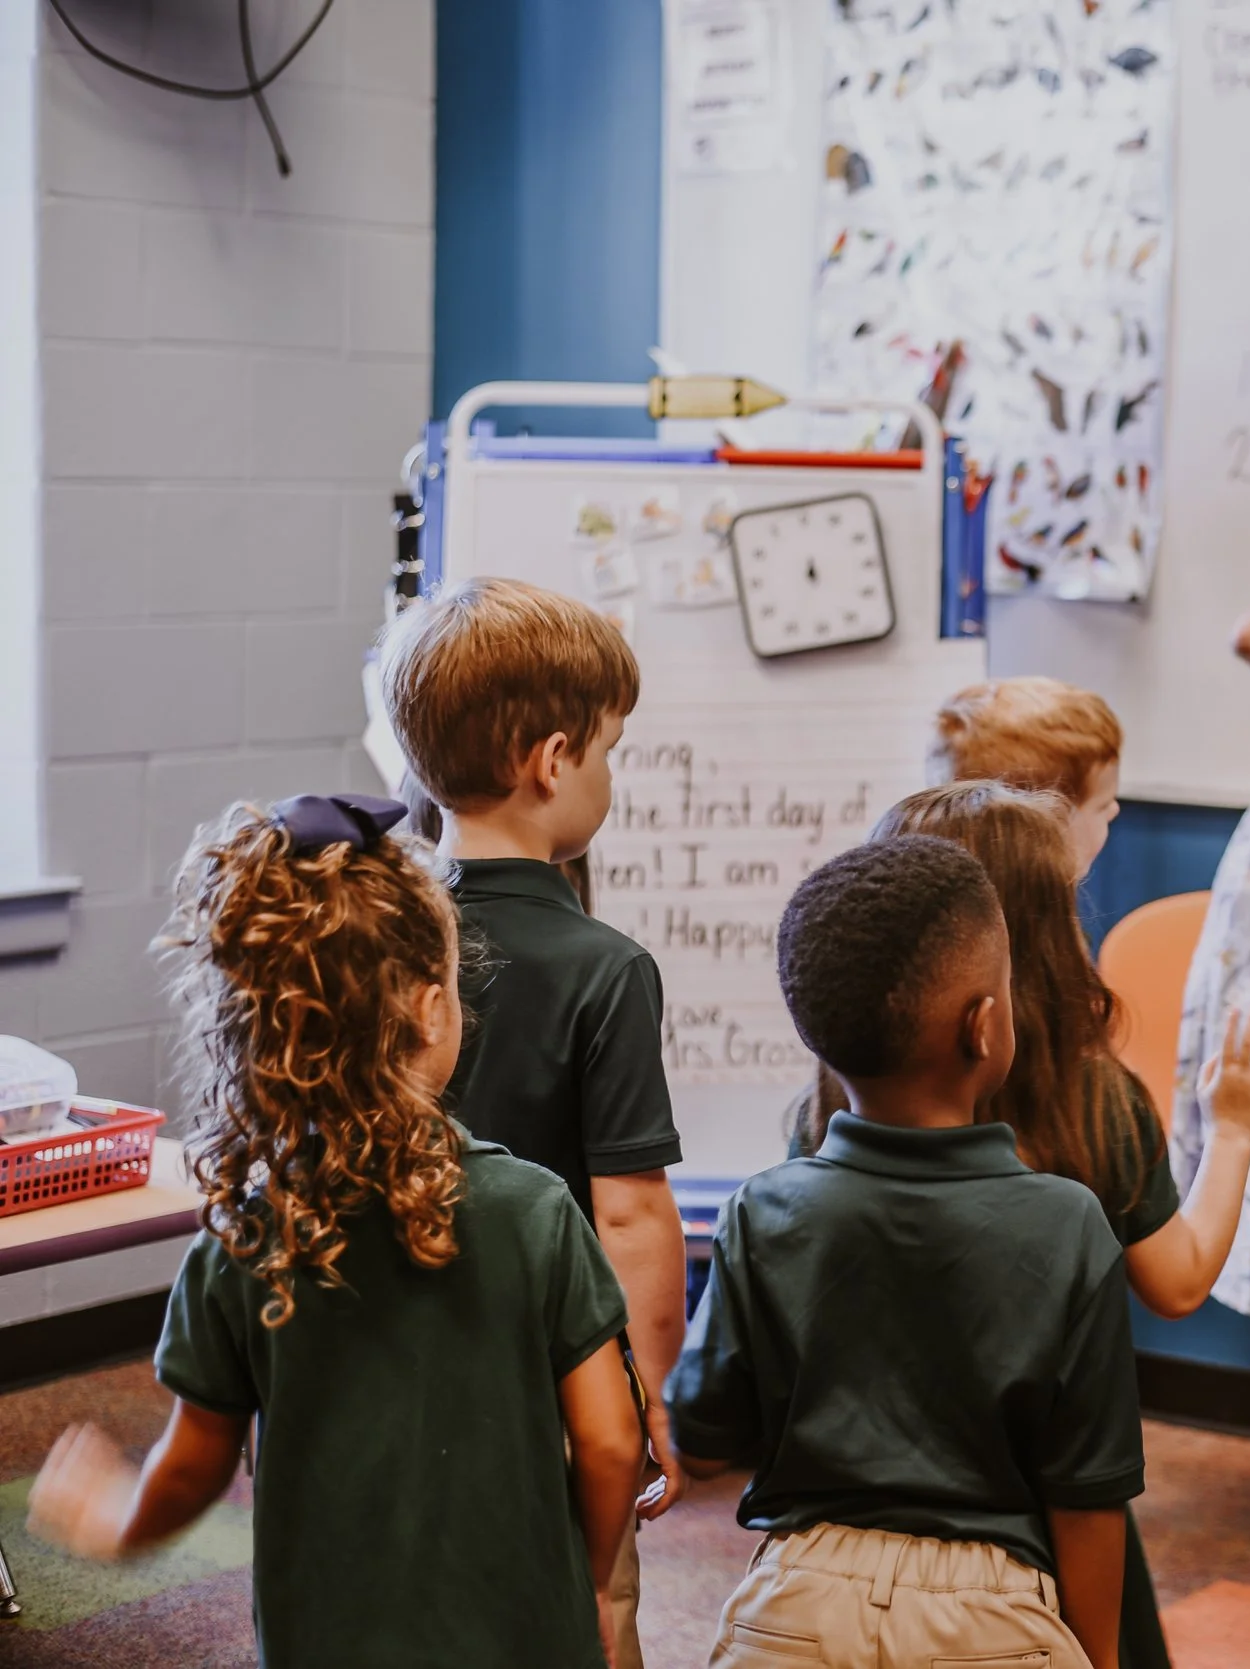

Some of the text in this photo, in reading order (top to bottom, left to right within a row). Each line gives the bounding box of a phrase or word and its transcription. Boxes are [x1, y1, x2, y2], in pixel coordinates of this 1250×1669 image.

[766, 785, 826, 846] day
[839, 780, 874, 826] of
[679, 843, 709, 888] I
[724, 860, 779, 887] am
